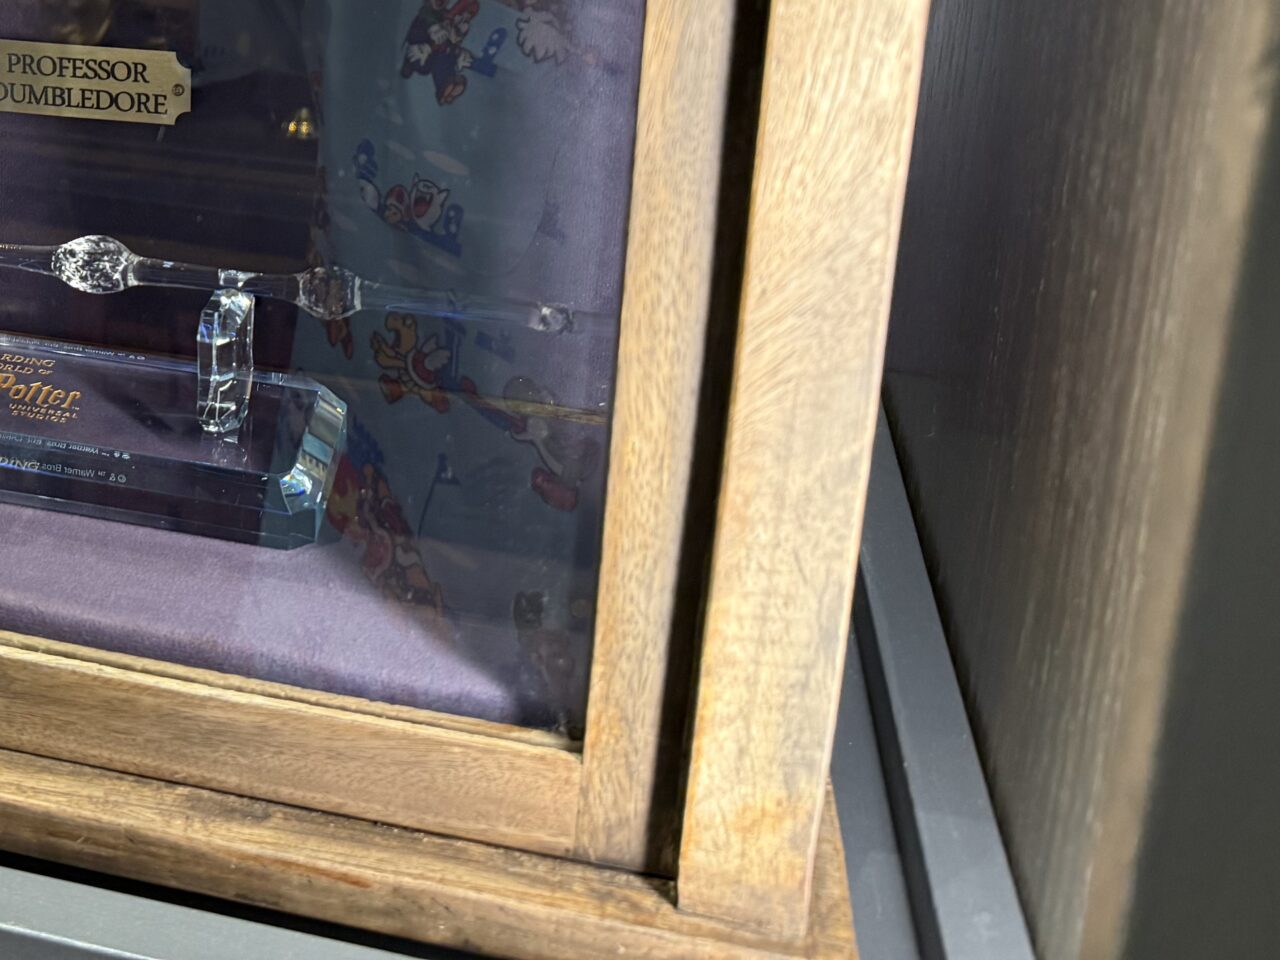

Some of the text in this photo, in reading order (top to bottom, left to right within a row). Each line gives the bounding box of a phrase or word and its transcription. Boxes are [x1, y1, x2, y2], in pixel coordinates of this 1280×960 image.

[6, 52, 150, 84] PROFESSOR
[8, 403, 79, 419] UNIVERSAL
[10, 410, 69, 423] STUDIOS
